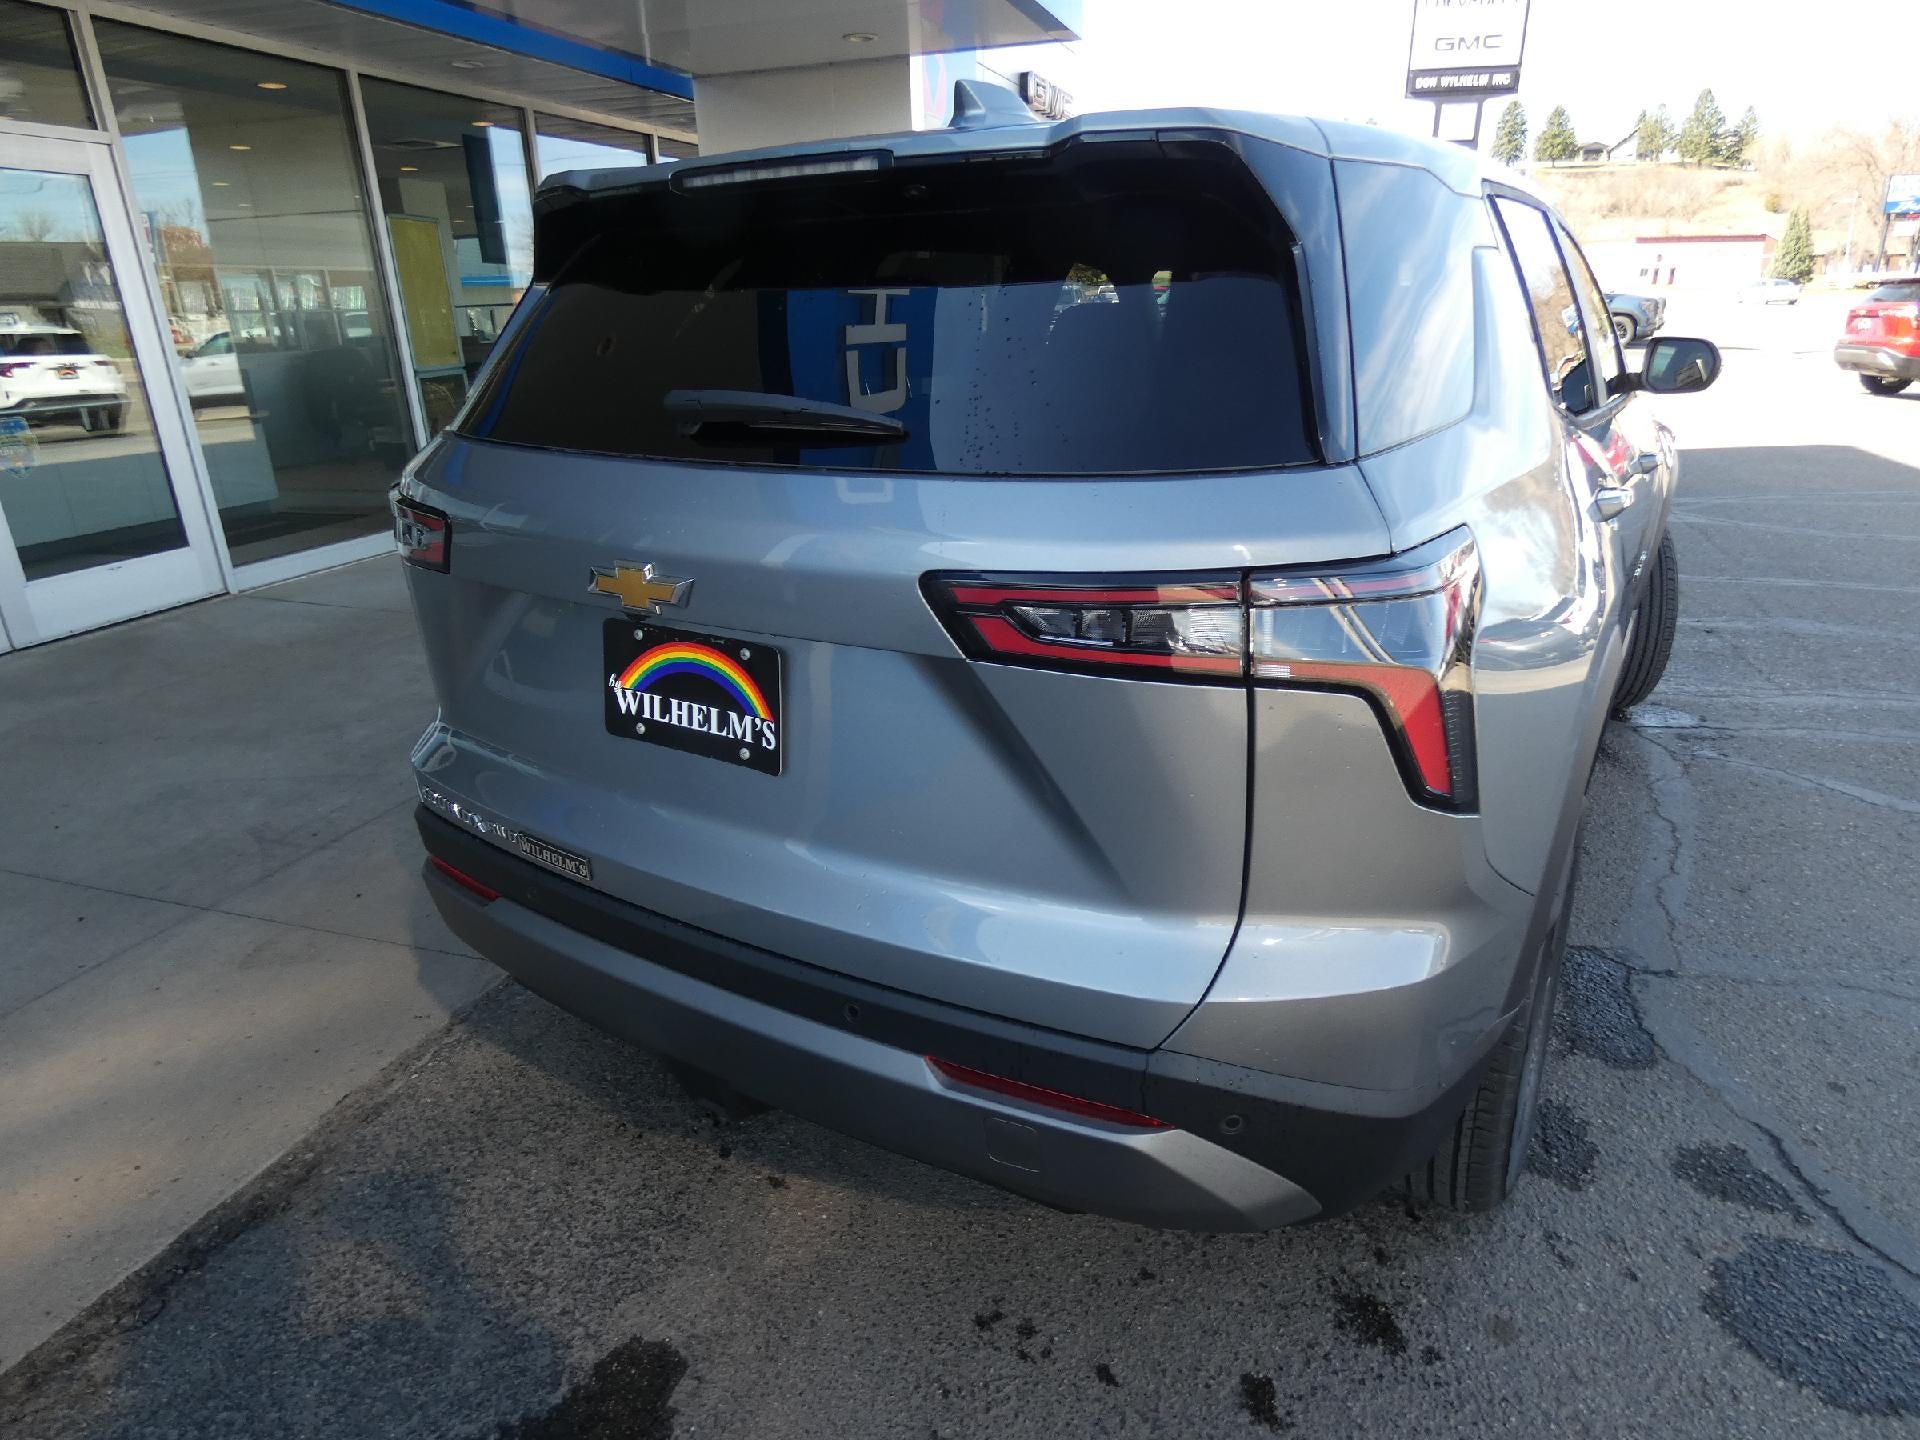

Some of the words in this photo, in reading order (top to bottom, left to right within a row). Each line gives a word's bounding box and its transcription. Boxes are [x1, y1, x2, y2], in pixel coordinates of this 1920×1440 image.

[1435, 34, 1503, 51] GMC
[614, 687, 777, 751] WILHELM'S
[519, 836, 588, 878] WILHELM'S
